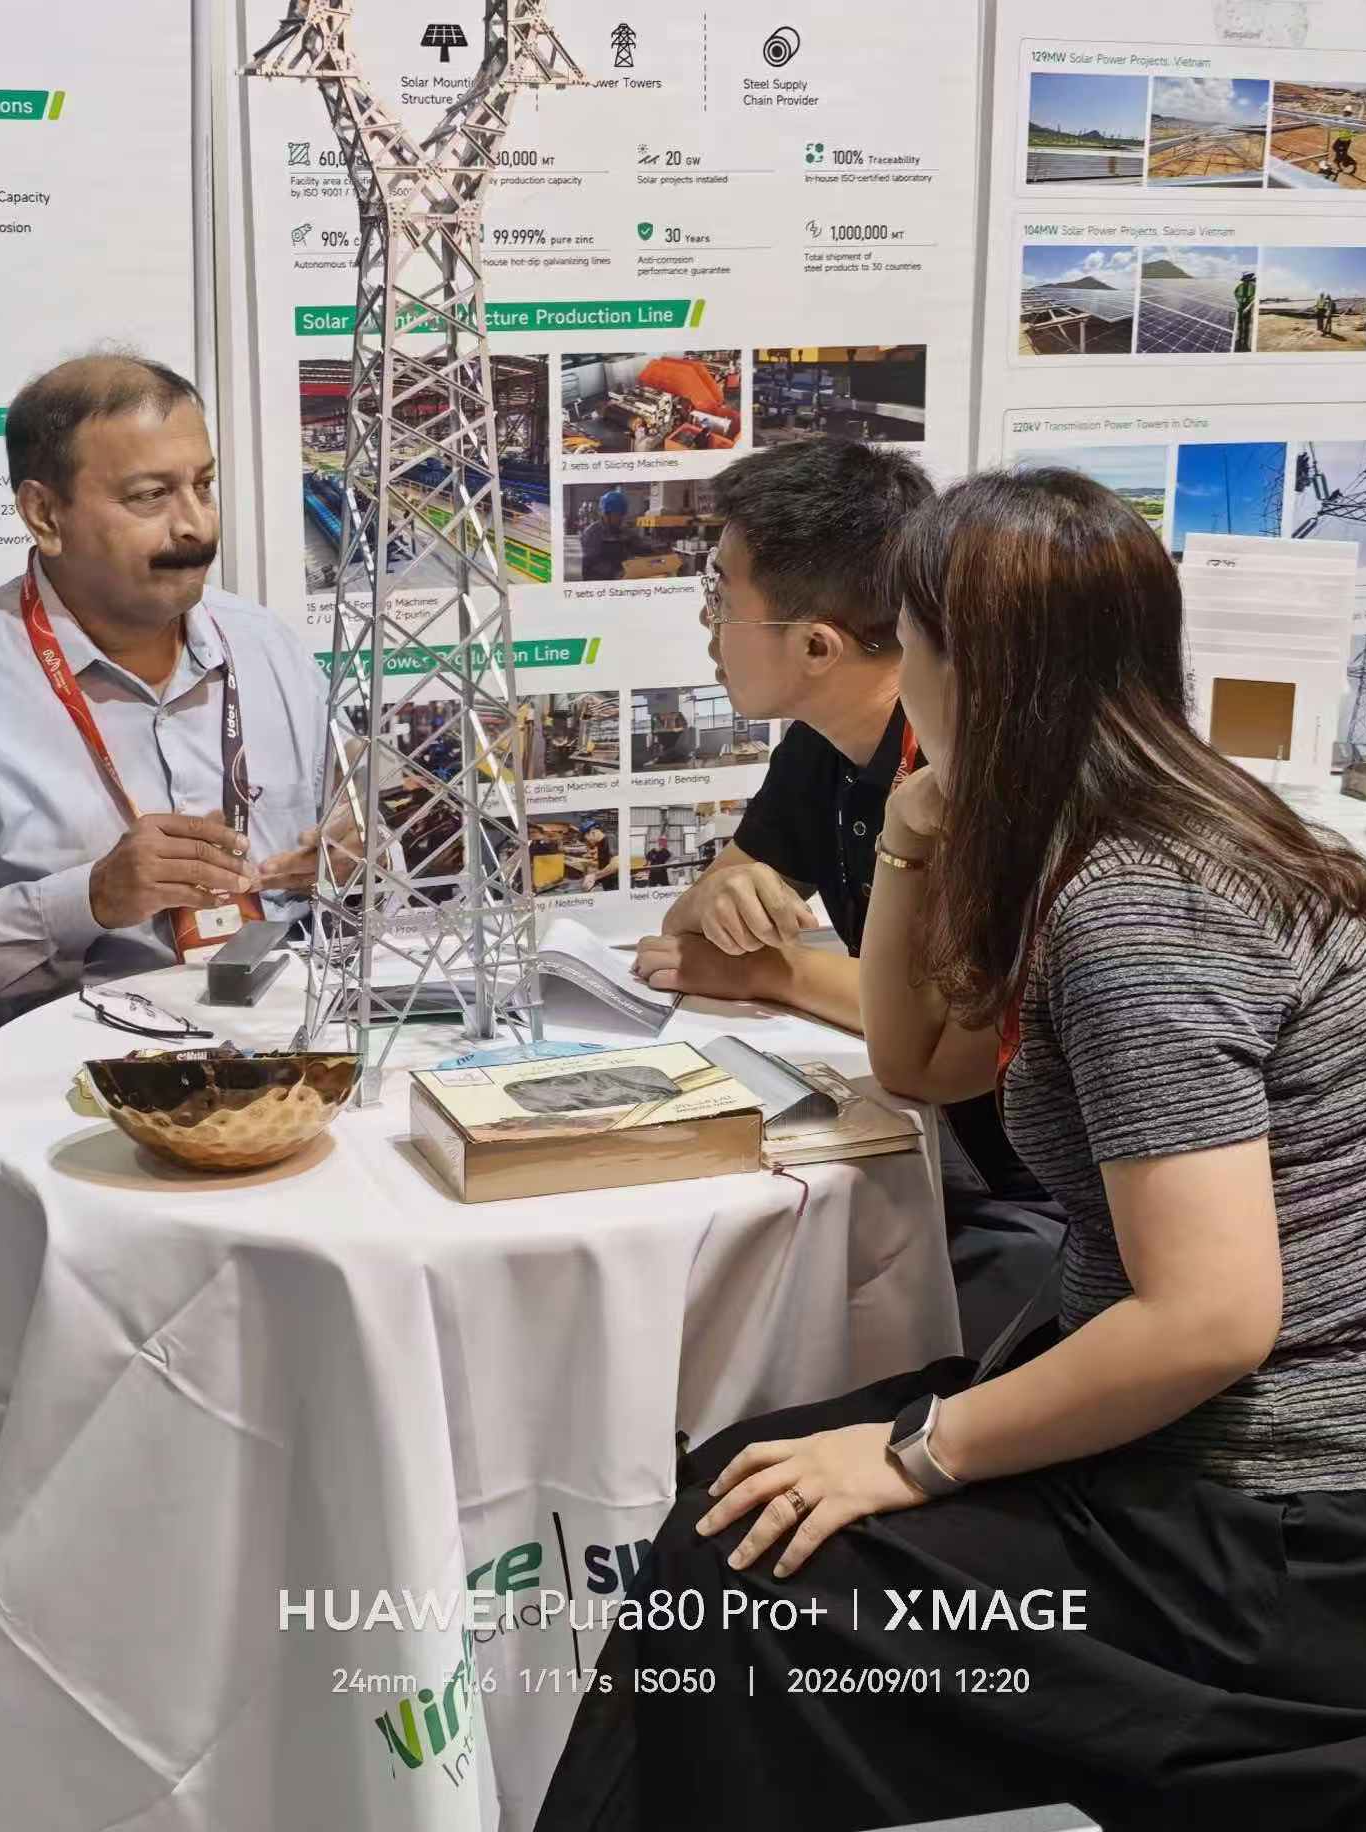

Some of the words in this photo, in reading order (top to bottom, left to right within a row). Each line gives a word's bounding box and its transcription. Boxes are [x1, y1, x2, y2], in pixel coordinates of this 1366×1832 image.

[401, 77, 428, 88] Solar
[623, 78, 662, 88] Towers
[743, 79, 769, 90] Steel
[773, 79, 808, 92] Supply
[401, 96, 453, 106] Structure
[743, 95, 773, 107] Chain
[776, 95, 819, 107] Provider
[542, 157, 555, 166] MT
[666, 150, 682, 166] 20
[686, 157, 700, 166] GW
[832, 149, 864, 165] 100%
[868, 155, 920, 165] Traceability
[322, 231, 349, 247] 90%
[665, 228, 681, 243] 30
[686, 235, 710, 243] Years
[831, 225, 888, 241] 1,000,000
[302, 313, 349, 330] Solar
[536, 309, 631, 327] Production
[638, 307, 673, 323] Line
[536, 646, 571, 662] Line
